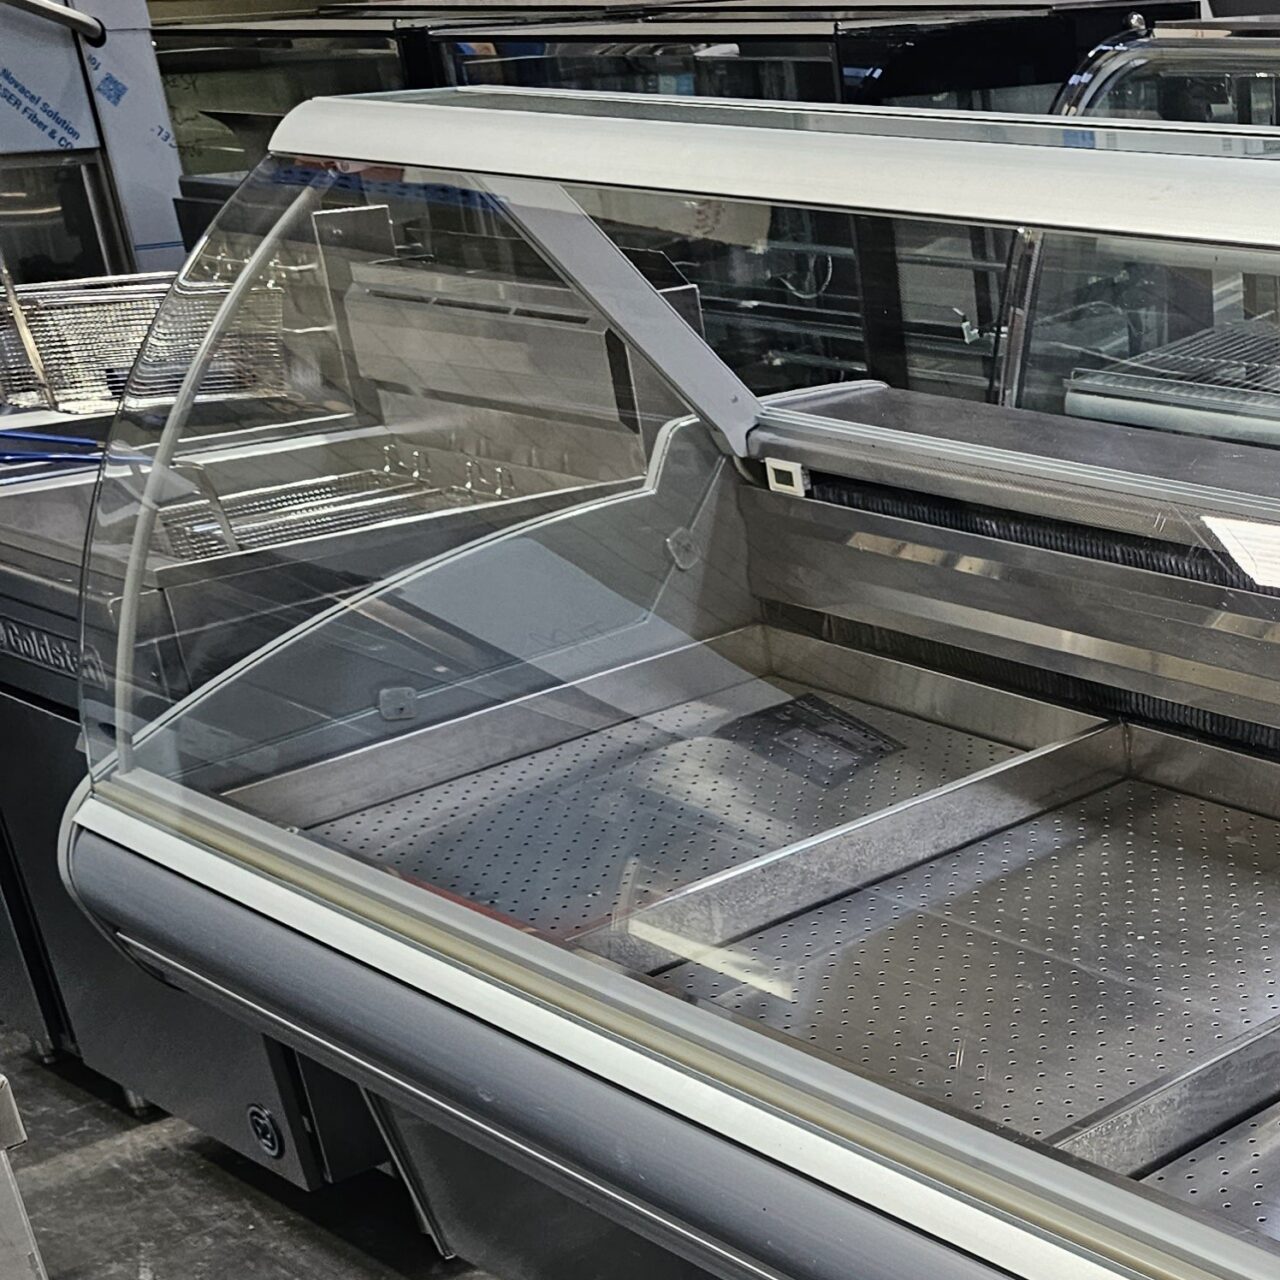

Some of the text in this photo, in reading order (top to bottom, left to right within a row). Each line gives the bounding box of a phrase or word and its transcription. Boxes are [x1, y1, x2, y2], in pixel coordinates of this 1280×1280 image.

[21, 106, 48, 132] Fiber
[48, 128, 57, 140] &
[40, 102, 80, 140] Solution
